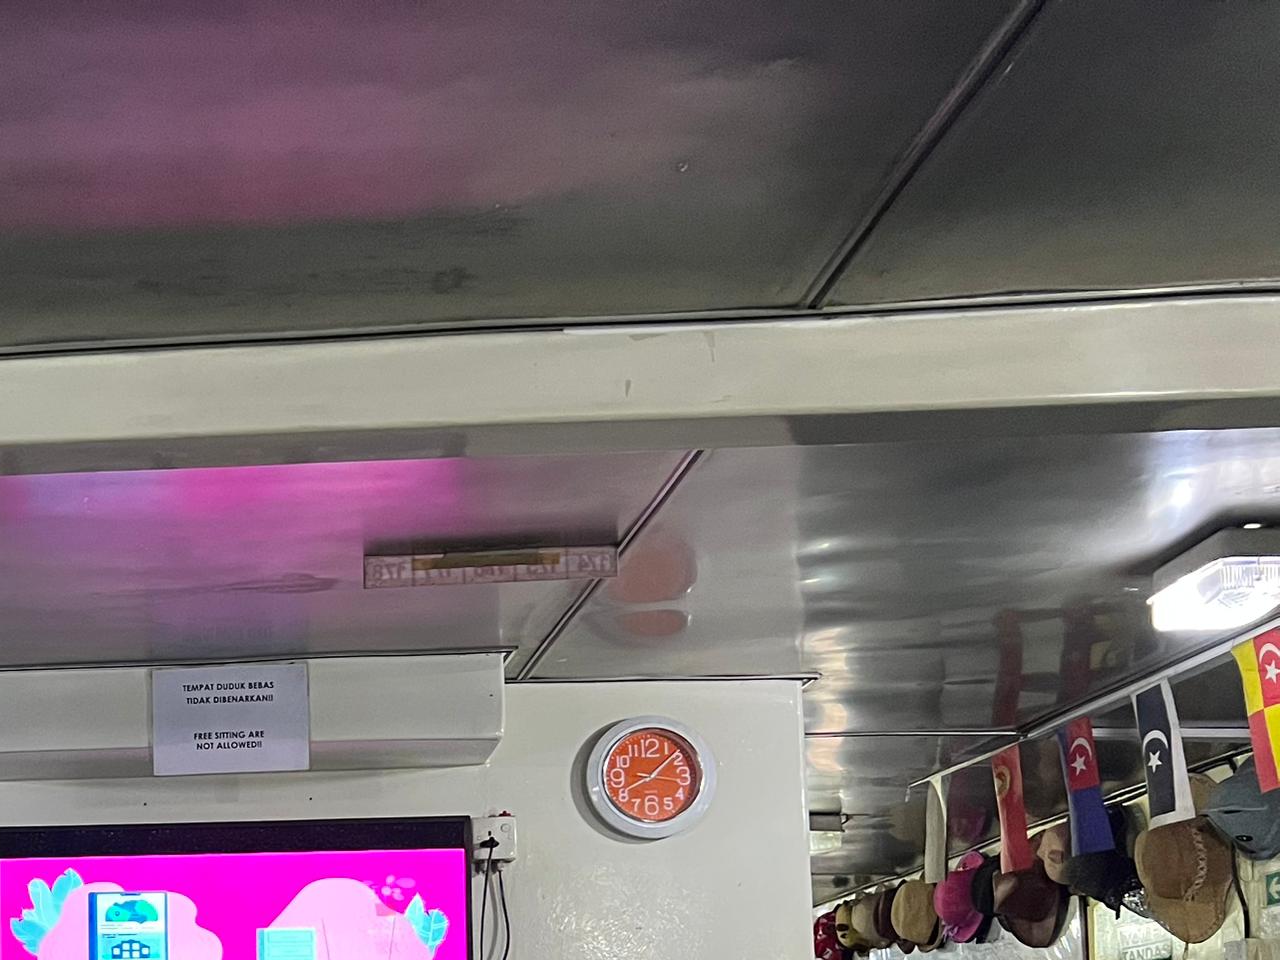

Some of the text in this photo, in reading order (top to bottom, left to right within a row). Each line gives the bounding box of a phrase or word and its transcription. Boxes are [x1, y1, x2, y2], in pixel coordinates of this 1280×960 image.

[183, 681, 274, 692] TEMPAT DUDUK BEBAS
[186, 697, 211, 705] TIDAK
[194, 730, 264, 740] FREE SITTING ARE
[196, 742, 214, 750] NOT
[628, 744, 638, 757] 11
[640, 739, 660, 758] 12
[664, 742, 669, 755] 1
[616, 755, 630, 768] 10
[673, 752, 683, 765] 2
[610, 768, 625, 787] 9
[676, 766, 690, 785] 3
[619, 789, 629, 802] 8
[676, 787, 684, 800] 4
[631, 799, 642, 811] 7
[644, 795, 659, 815] 6
[663, 798, 673, 810] 5
